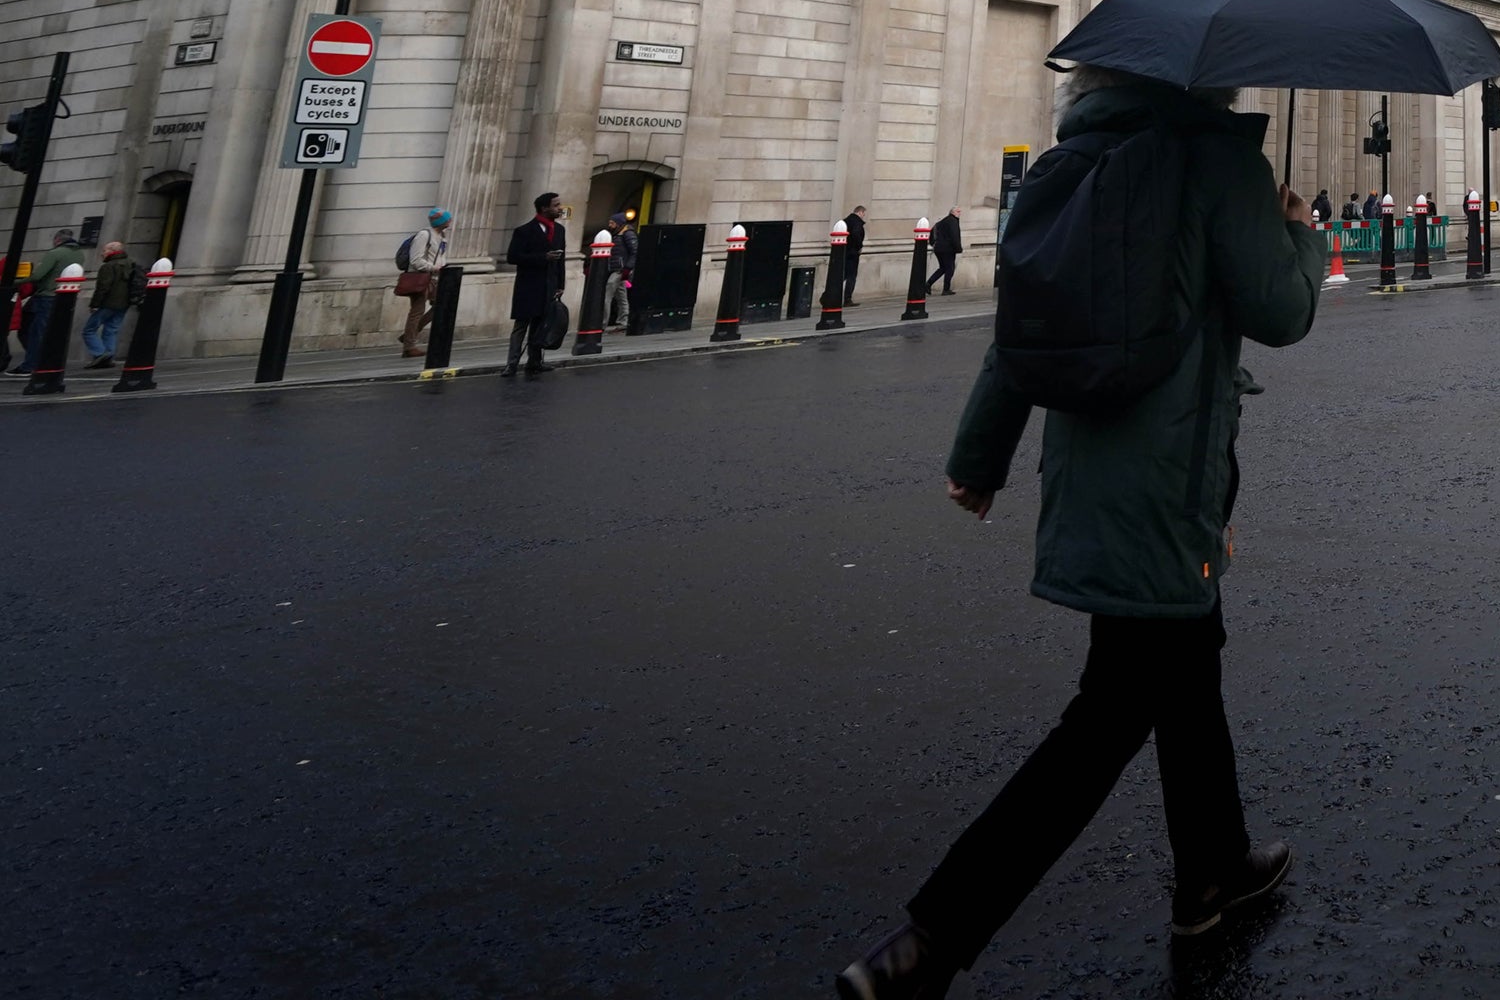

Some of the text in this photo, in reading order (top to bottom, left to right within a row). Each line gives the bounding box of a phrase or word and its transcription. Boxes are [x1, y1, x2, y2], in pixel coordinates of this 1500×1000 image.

[638, 46, 679, 54] THREADNEEDLE
[310, 84, 356, 96] Except
[304, 96, 356, 107] buses &
[307, 109, 350, 120] cycles
[598, 115, 682, 128] UNDERGROUND
[152, 121, 206, 135] UNDERGROUN
